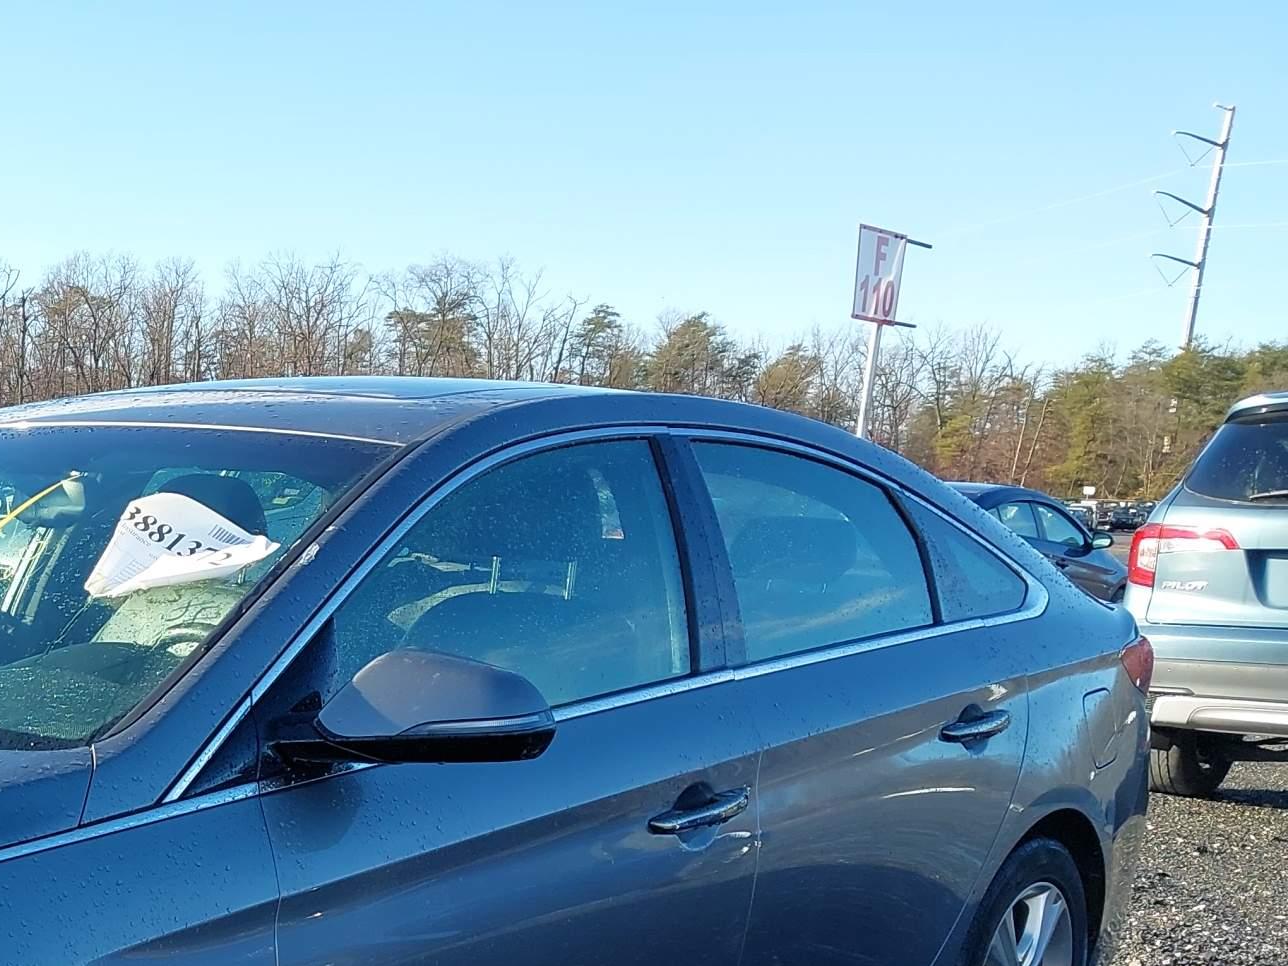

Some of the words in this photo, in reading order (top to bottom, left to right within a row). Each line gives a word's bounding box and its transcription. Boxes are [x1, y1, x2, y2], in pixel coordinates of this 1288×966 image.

[873, 235, 890, 277] F
[859, 274, 895, 318] 110
[1161, 580, 1209, 592] PILOT
